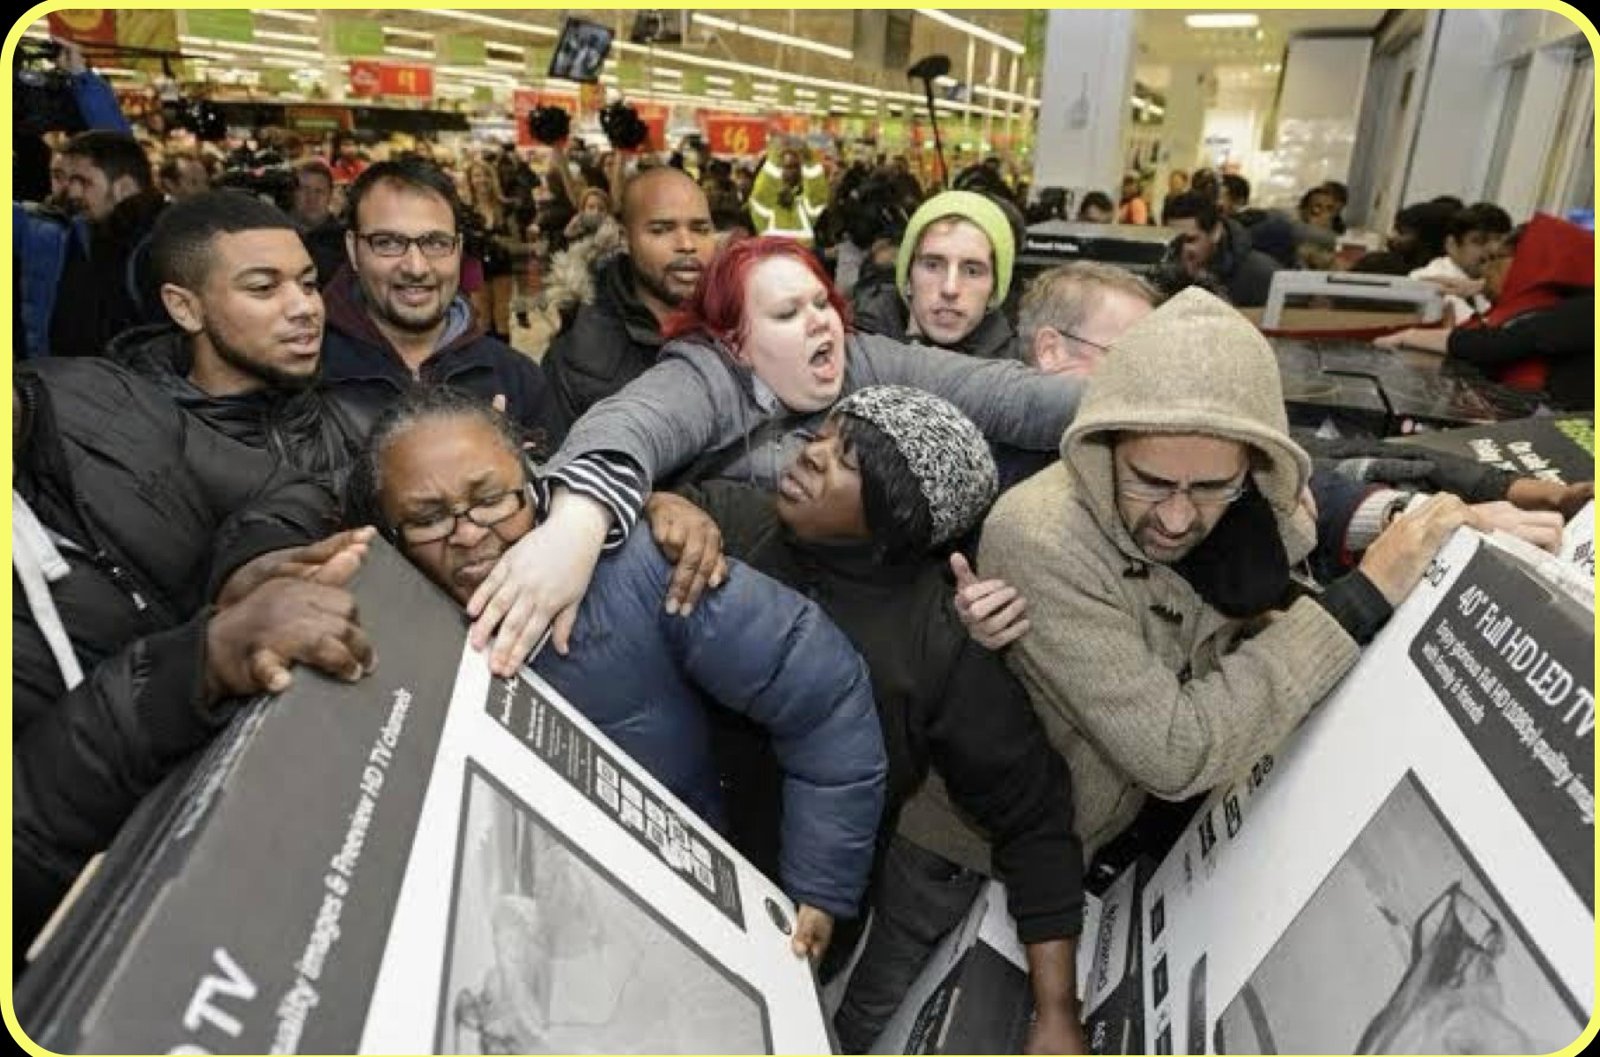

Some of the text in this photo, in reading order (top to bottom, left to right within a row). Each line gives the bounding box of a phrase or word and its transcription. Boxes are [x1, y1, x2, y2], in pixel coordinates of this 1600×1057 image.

[1458, 583, 1490, 616] 40"
[1474, 602, 1513, 649] Full
[1499, 626, 1539, 672] HD
[1525, 651, 1574, 706] LED
[369, 738, 393, 769] TV
[379, 688, 413, 749] channels
[359, 764, 385, 799] HD
[331, 793, 376, 878] Freeview
[293, 893, 344, 981] images
[183, 946, 258, 1038] TV
